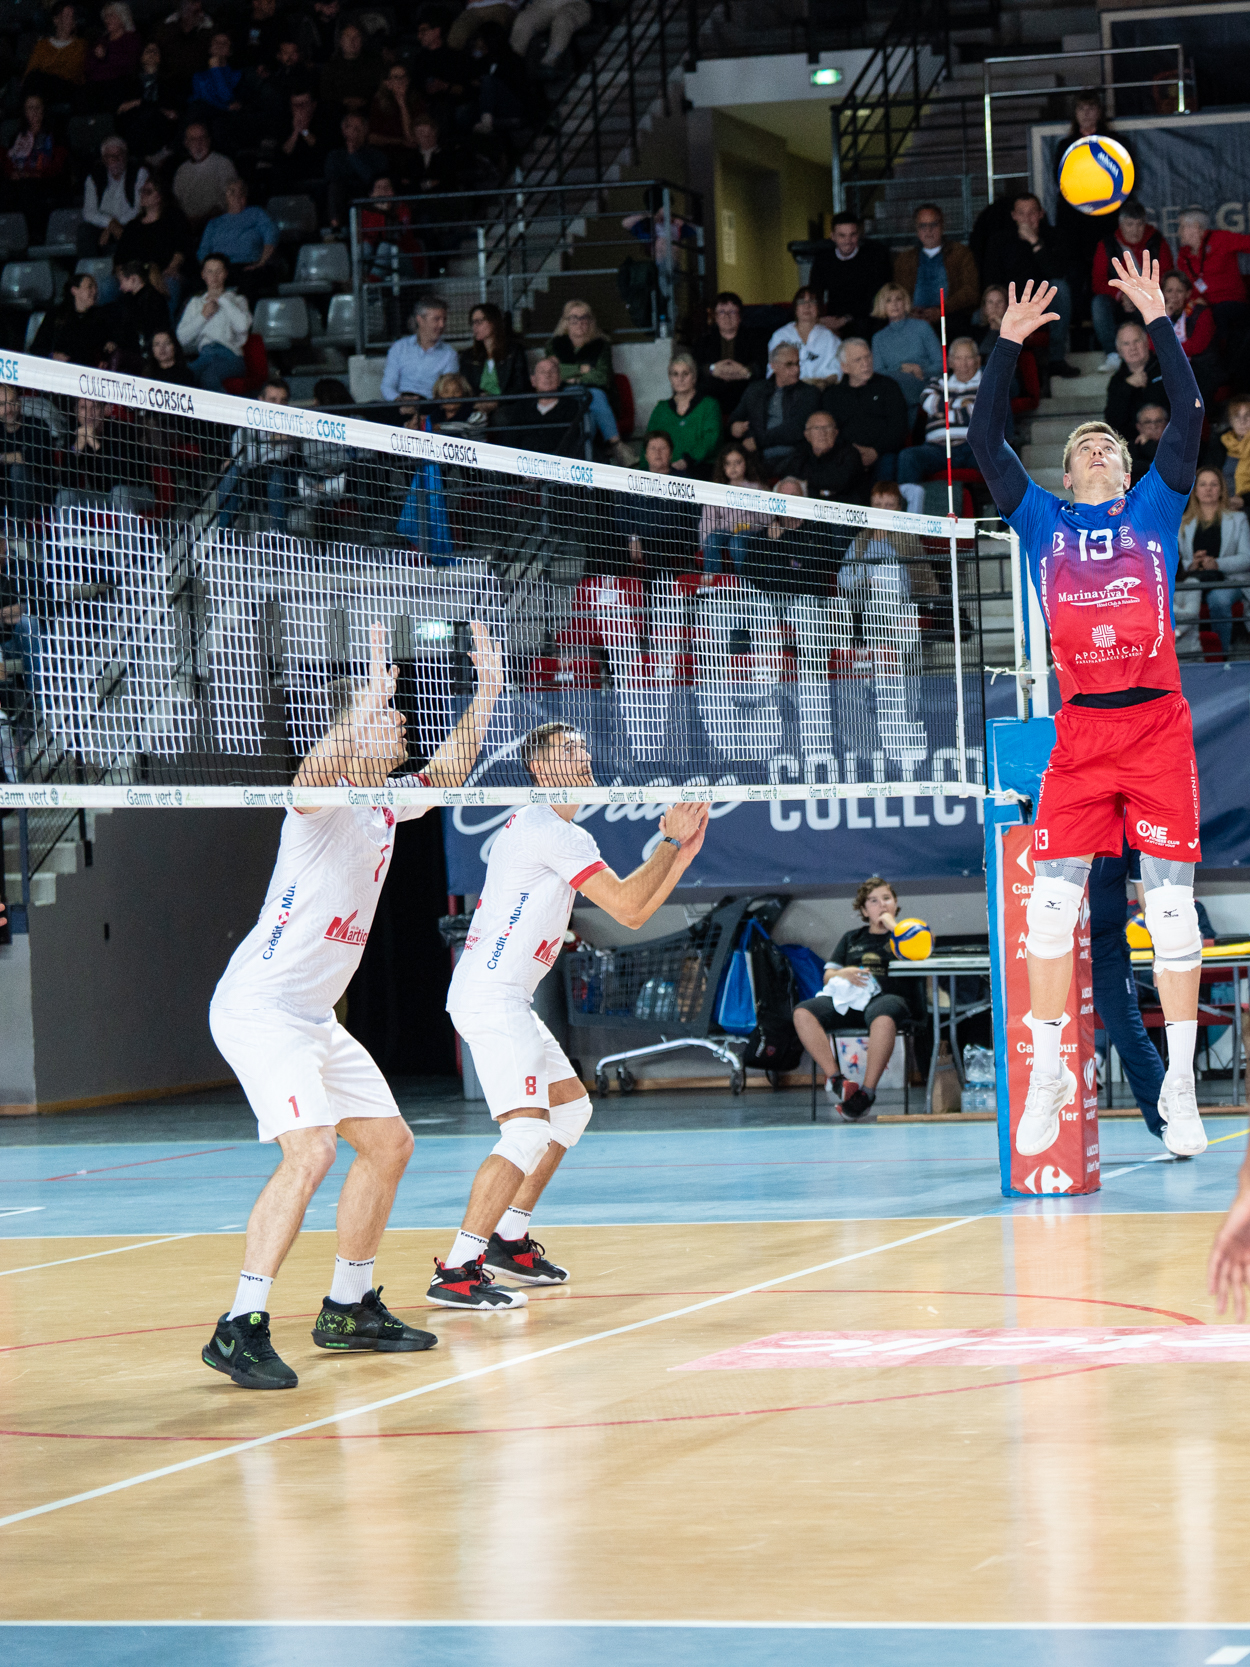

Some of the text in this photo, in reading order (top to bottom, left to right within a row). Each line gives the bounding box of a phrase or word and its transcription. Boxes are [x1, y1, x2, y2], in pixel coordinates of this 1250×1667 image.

[79, 373, 195, 415] CULLETTIVITÀ DI CORSICA
[246, 405, 305, 435] COLLECTIVITÉ
[317, 418, 346, 442] CORSE
[390, 432, 435, 456] CULLETTIVITÀ
[442, 442, 478, 465] CORSICA
[516, 454, 562, 479] COLLECTIVITÉ
[570, 464, 594, 484] CORSE
[668, 480, 696, 500] CORSICA
[768, 497, 787, 514] CORSE
[845, 508, 869, 525] CORSICA
[926, 519, 943, 534] CORSE
[1076, 527, 1114, 562] 13
[1150, 552, 1163, 583] AIR
[1040, 556, 1052, 623] ORSICA
[28, 788, 47, 806] vert
[126, 789, 172, 806] Gamm vert
[243, 789, 284, 806] Gamm vert
[348, 790, 386, 805] Gamm vert
[443, 790, 477, 805] Gamm vert
[529, 789, 562, 804] Gamm vert
[1034, 829, 1049, 850] 13
[486, 892, 530, 971] Crédit Muel
[262, 924, 286, 961] Crédit
[1016, 1042, 1078, 1054] Caour
[524, 1075, 537, 1096] 8
[287, 1095, 300, 1118] 1
[1061, 1110, 1079, 1122] 1er
